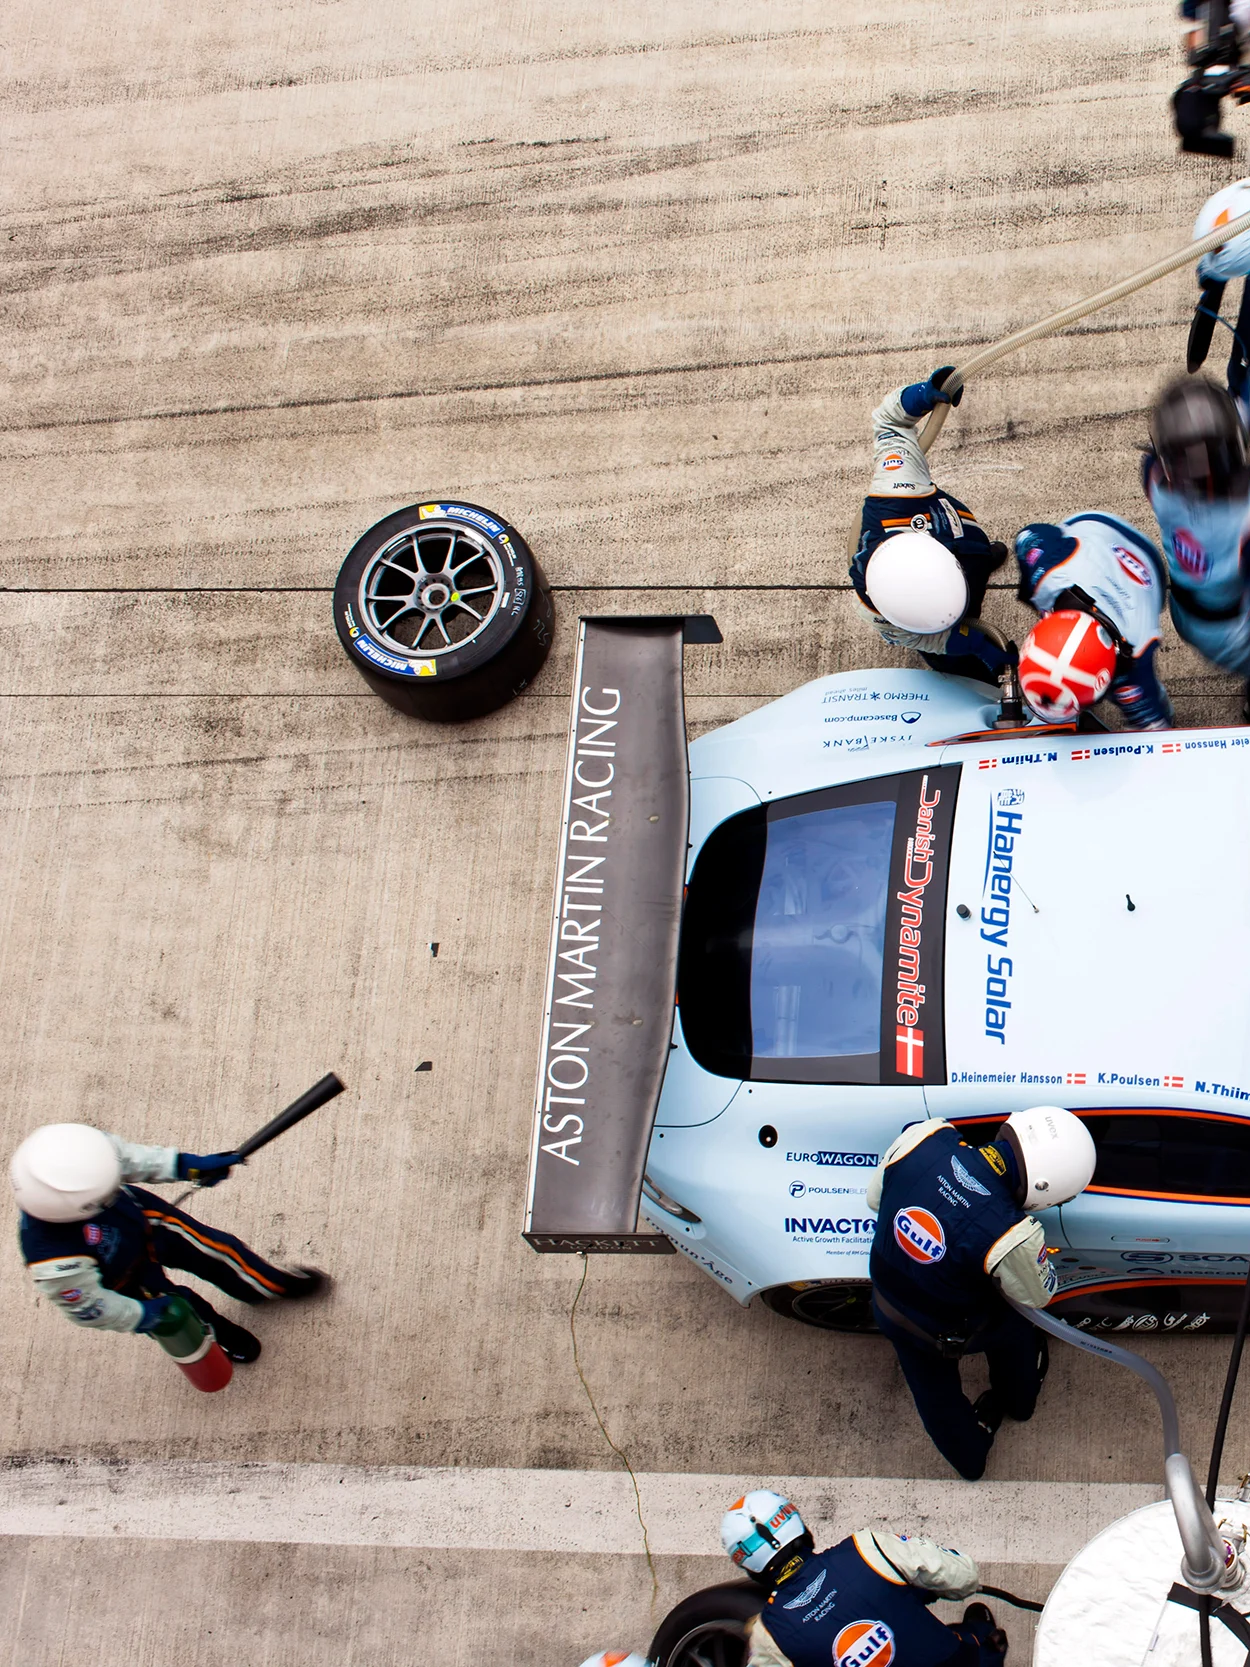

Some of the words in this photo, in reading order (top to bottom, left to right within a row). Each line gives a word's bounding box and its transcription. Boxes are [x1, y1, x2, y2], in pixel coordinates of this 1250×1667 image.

[447, 506, 502, 534] MICHELIN
[355, 638, 408, 672] MICHELIN
[822, 692, 868, 704] TRANSIT
[884, 692, 930, 702] THERMO
[824, 714, 898, 724] Basecamp.com
[823, 738, 863, 749] BANK
[871, 735, 913, 744] JYSKE
[1184, 738, 1227, 750] Hansson
[1001, 751, 1058, 765] N.Thiim
[1093, 743, 1154, 757] K.Poulsen
[569, 686, 621, 844] RACING
[980, 810, 1023, 948] Hanergy
[557, 854, 606, 1009] MARTIN
[985, 953, 1014, 1045] Solar
[950, 1071, 1017, 1084] D.Heinemeier
[1020, 1072, 1063, 1085] Hansson
[1097, 1072, 1161, 1087] K.Poulsen
[541, 1021, 593, 1166] ASTON
[1044, 1115, 1059, 1140] uvex
[937, 1174, 953, 1192] ASTON
[950, 1188, 972, 1209] MARTIN
[938, 1187, 958, 1207] RACING
[532, 1238, 660, 1247] HACKETT
[792, 1235, 814, 1243] Active
[814, 1235, 840, 1244] Growth
[896, 1214, 943, 1258] Gulf
[802, 1606, 820, 1623] ASTON
[814, 1601, 836, 1622] RACING
[840, 1626, 889, 1667] Gulf
